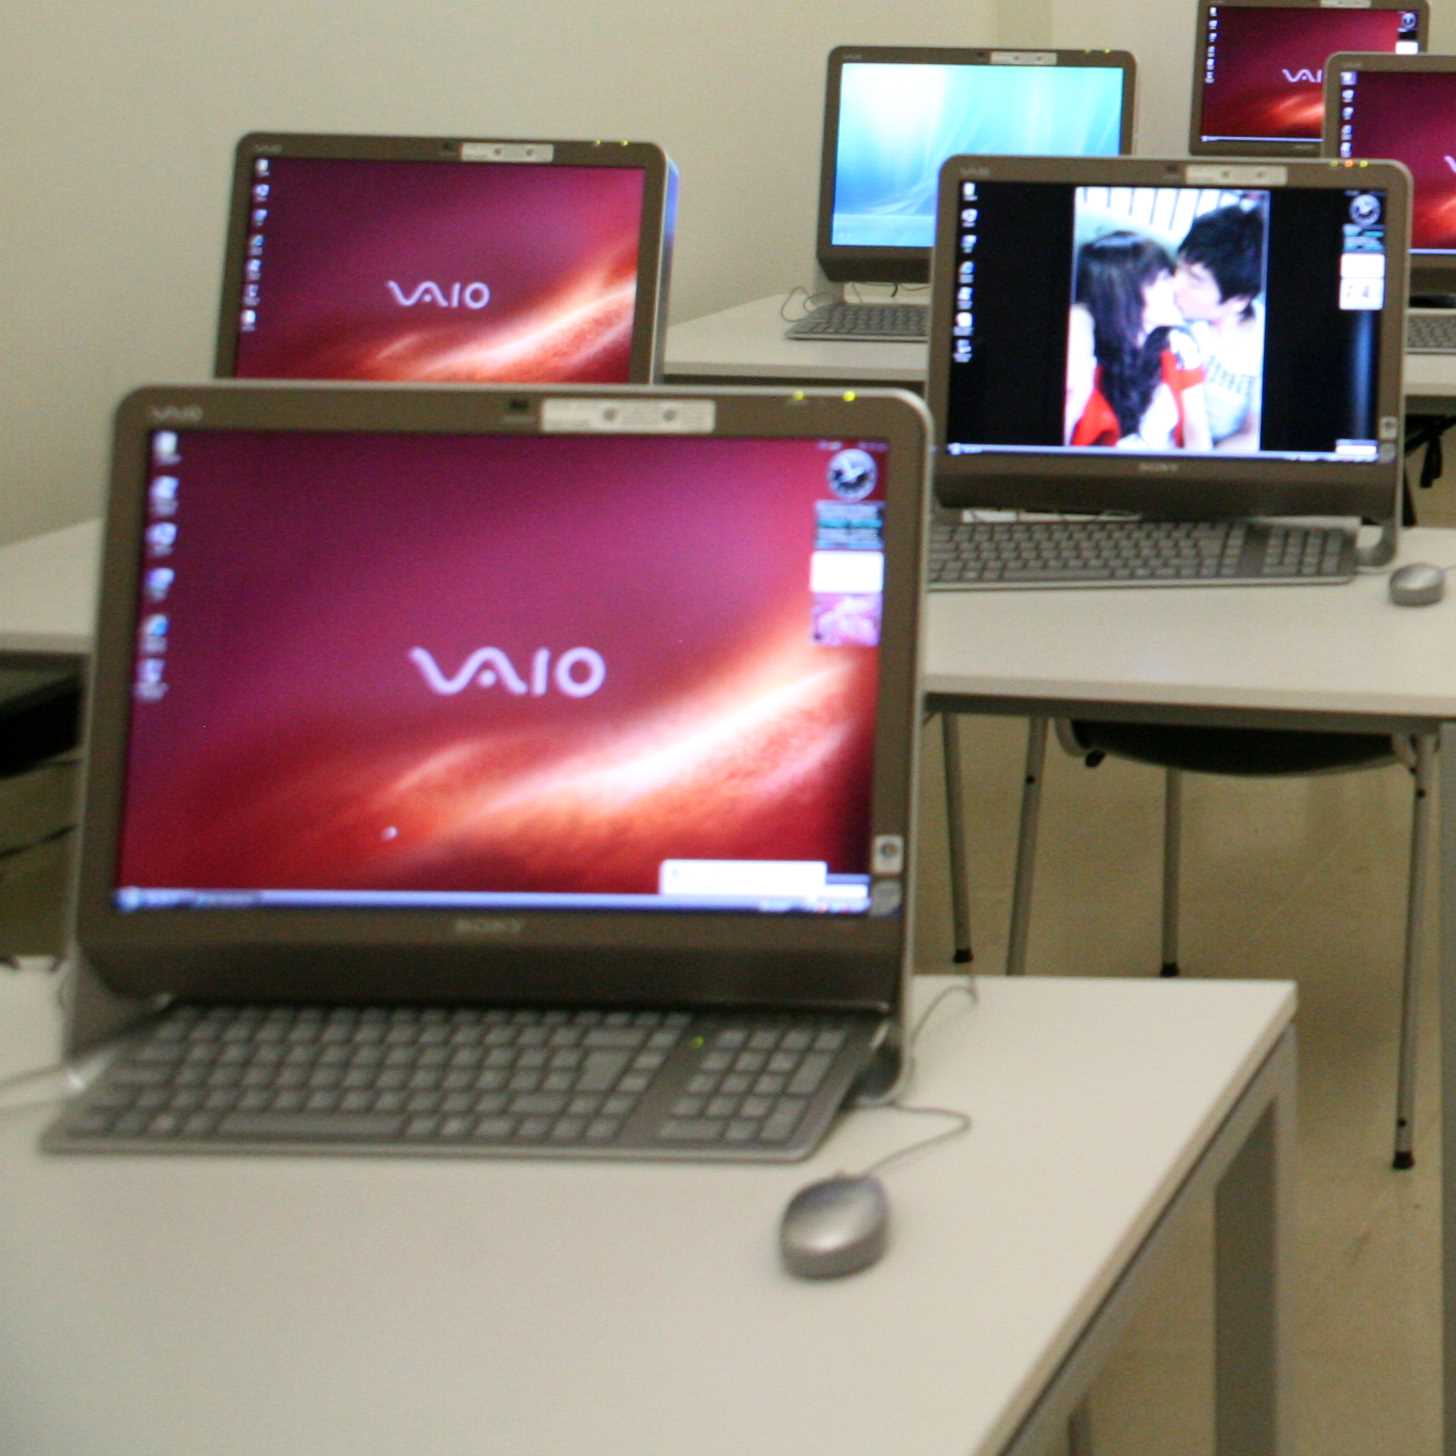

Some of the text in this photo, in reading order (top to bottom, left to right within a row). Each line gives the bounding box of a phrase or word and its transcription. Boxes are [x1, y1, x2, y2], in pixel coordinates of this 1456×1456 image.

[1281, 68, 1323, 84] VAI
[386, 280, 491, 310] VAIO
[409, 645, 607, 699] VAIO
